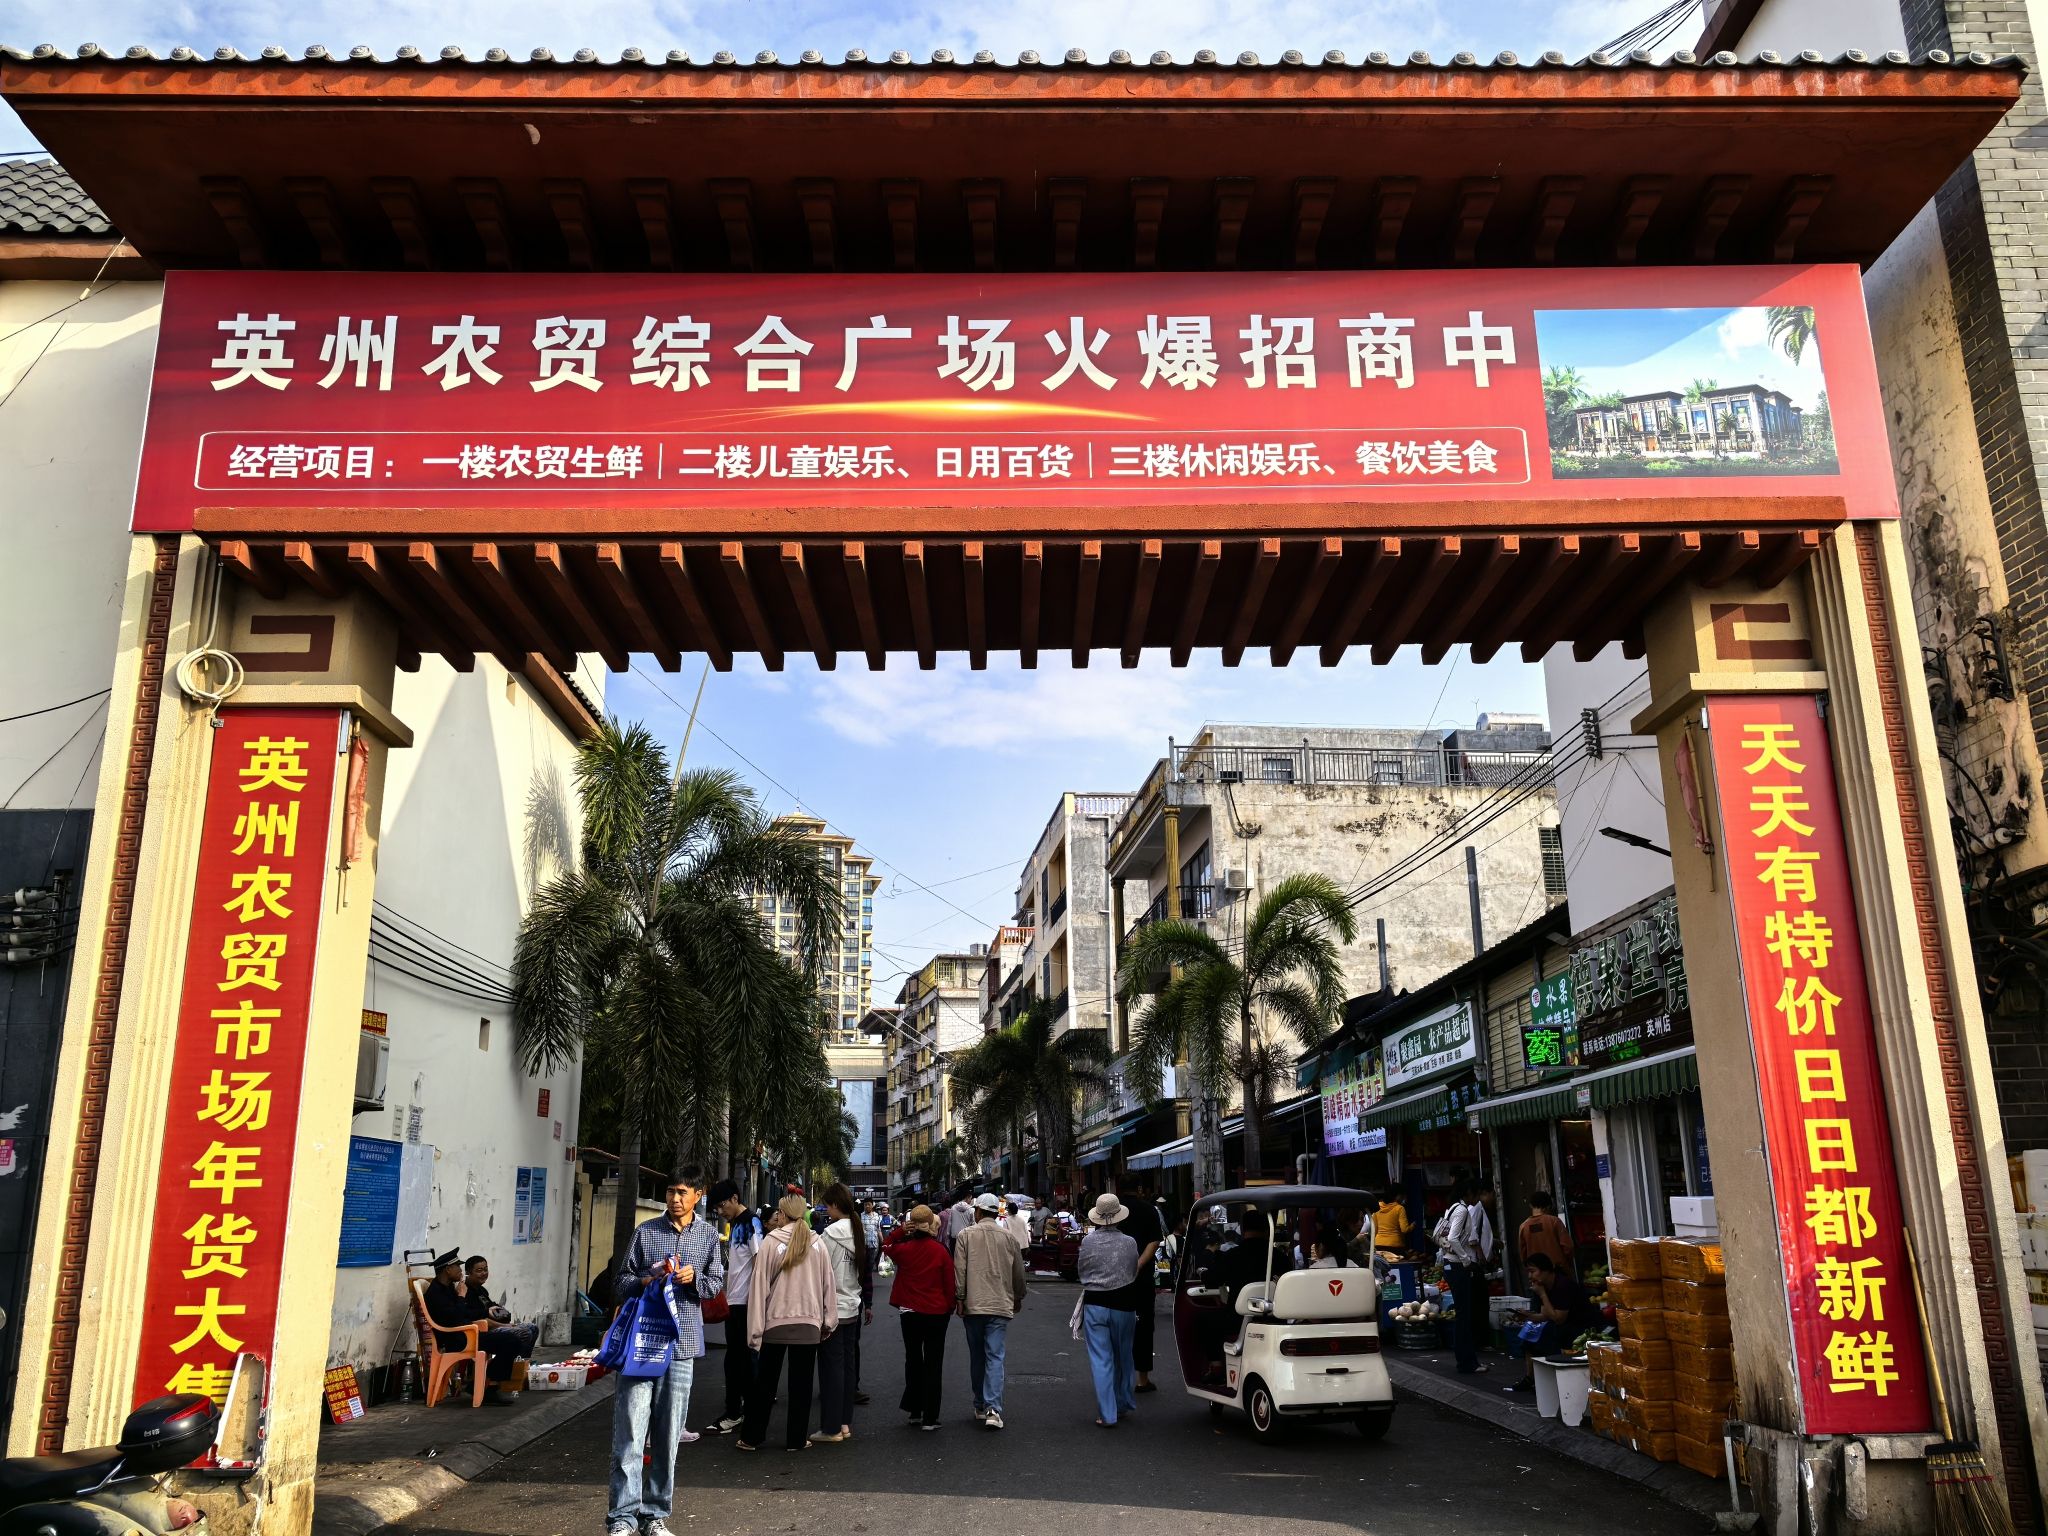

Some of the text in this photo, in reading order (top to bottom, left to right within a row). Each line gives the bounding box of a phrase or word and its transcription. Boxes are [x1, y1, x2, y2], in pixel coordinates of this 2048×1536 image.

[209, 310, 1518, 394] 英州农贸综合广场火爆招商中
[422, 443, 644, 480] 一楼农贸生鲜
[678, 443, 1074, 480] 二楼儿童娱乐、日用百货
[1107, 440, 1499, 478] 三楼休闲娱乐、餐饮美食
[1646, 1014, 1672, 1038] 英州店
[1524, 1030, 1560, 1065] 药
[1741, 723, 1900, 1398] 天天有特价日日都新鲜
